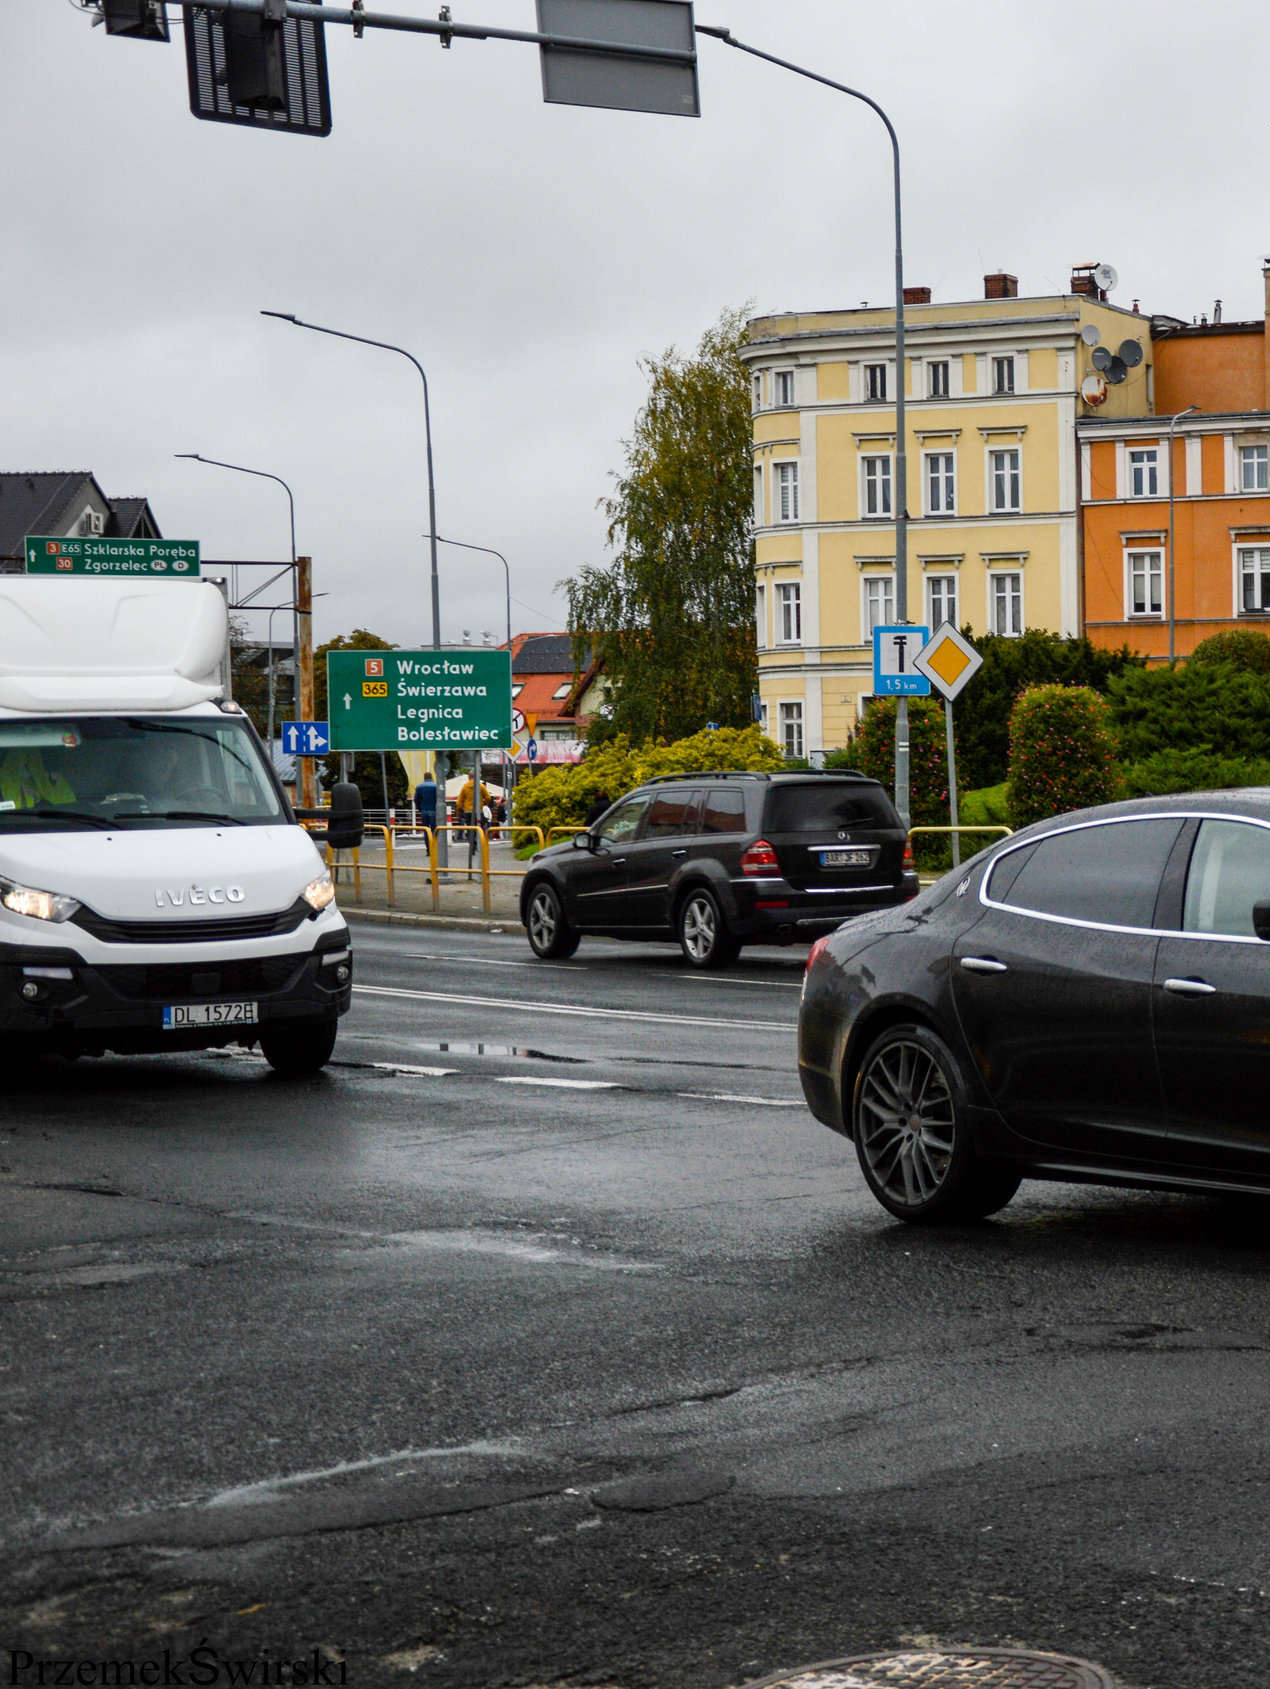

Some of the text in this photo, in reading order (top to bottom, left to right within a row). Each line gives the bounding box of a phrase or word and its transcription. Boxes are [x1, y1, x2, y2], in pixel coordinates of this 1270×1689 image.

[49, 543, 196, 560] 3 E65 Szklarska Poręba
[58, 559, 71, 568] 30
[84, 559, 148, 573] Zgorzelec
[153, 561, 165, 569] PL
[370, 660, 474, 675] 5 Wrocław
[363, 678, 487, 697] 365 Świerzawa
[886, 679, 917, 691] 1,5 km
[397, 705, 463, 723] Legnica
[398, 726, 499, 741] Bolesławiec
[155, 885, 245, 907] IVECO
[174, 1007, 196, 1023] DL
